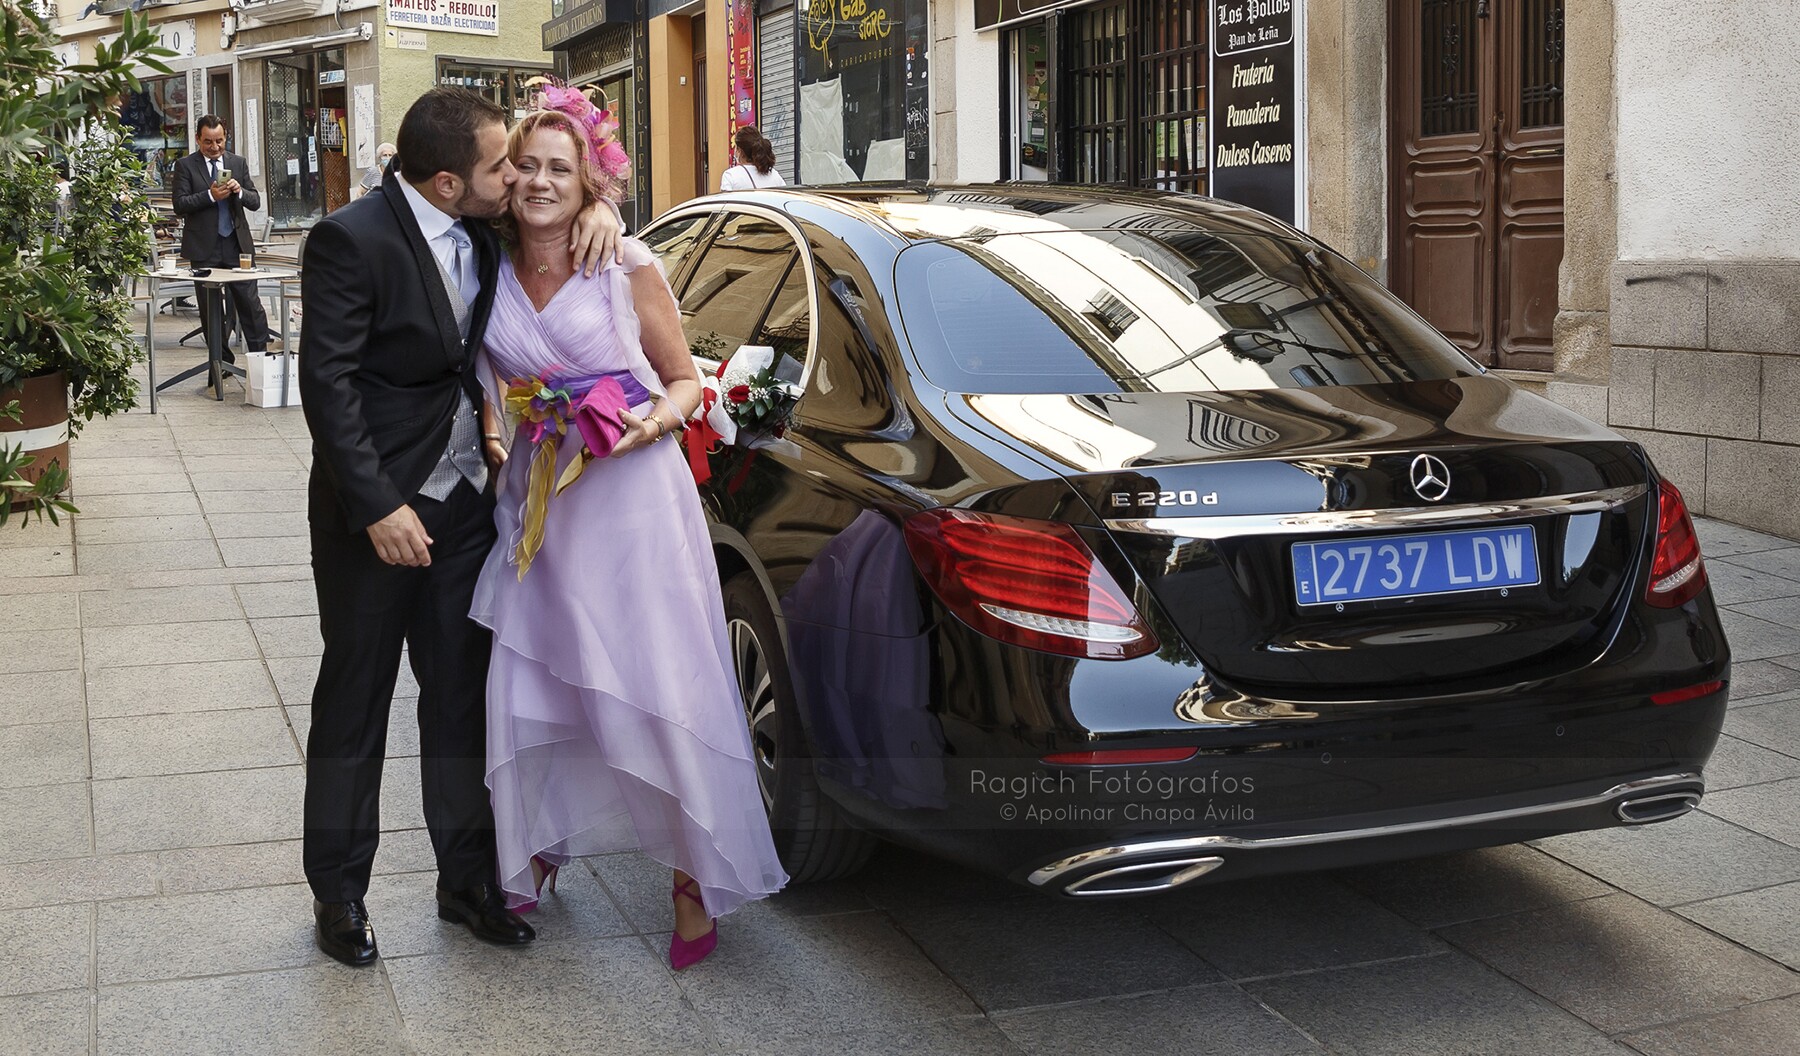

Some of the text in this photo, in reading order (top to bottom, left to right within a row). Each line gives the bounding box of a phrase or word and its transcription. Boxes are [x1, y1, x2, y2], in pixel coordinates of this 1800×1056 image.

[394, 0, 437, 12] MATEOS
[449, 1, 491, 17] REBOLLO
[1217, 0, 1291, 27] Los Pollos
[390, 10, 428, 24] FERRETERIA
[454, 17, 496, 31] ELECTRICIDAD
[544, 3, 604, 46] PRODUCTOS EXTREMEÑOS
[1228, 25, 1279, 50] Pan de Leña
[840, 46, 893, 68] CARICATURAS
[1216, 140, 1292, 167] Dulces Caseros
[1111, 490, 1218, 507] E 220 d
[1320, 533, 1523, 597] 2737 LDW
[1301, 580, 1310, 595] E
